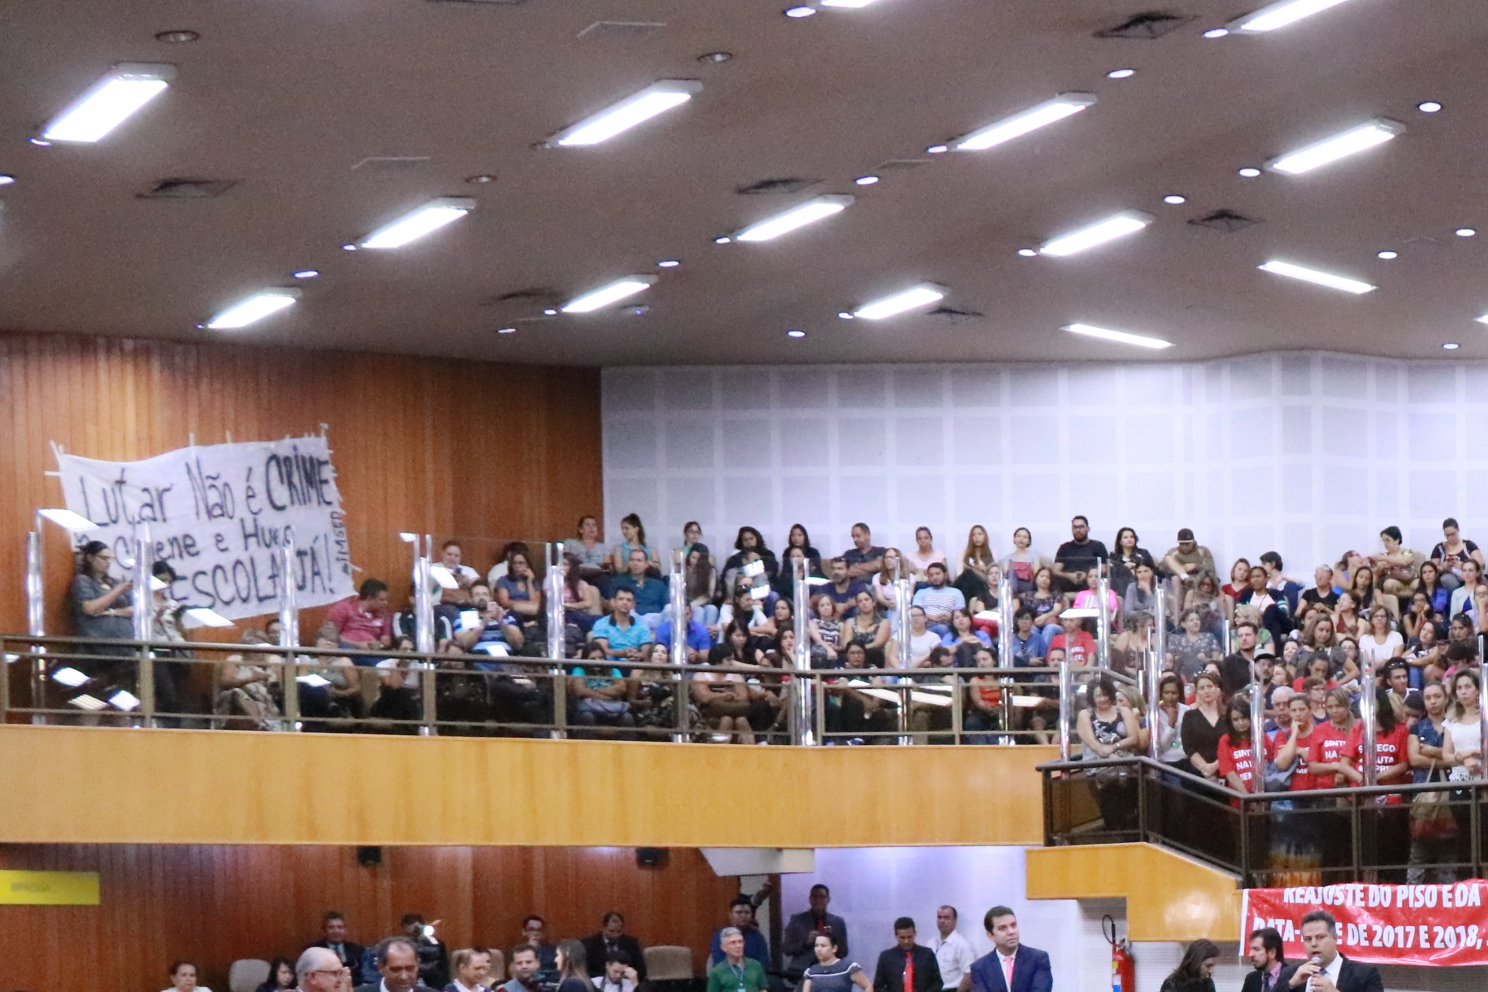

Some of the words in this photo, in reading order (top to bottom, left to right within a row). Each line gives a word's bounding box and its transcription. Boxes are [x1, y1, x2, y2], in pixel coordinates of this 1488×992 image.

[80, 468, 173, 527] Lutar
[185, 456, 235, 522] Não
[245, 466, 263, 515] é
[264, 444, 333, 512] CRIME
[1283, 883, 1366, 907] REAJUSTE
[1368, 884, 1392, 908] DO
[1396, 883, 1438, 908] PISO
[1442, 884, 1453, 908] E
[1455, 883, 1481, 908] DA
[1347, 923, 1370, 947] DE
[1372, 924, 1416, 949] 2017
[1419, 925, 1431, 949] E
[1433, 924, 1483, 950] 2018,
